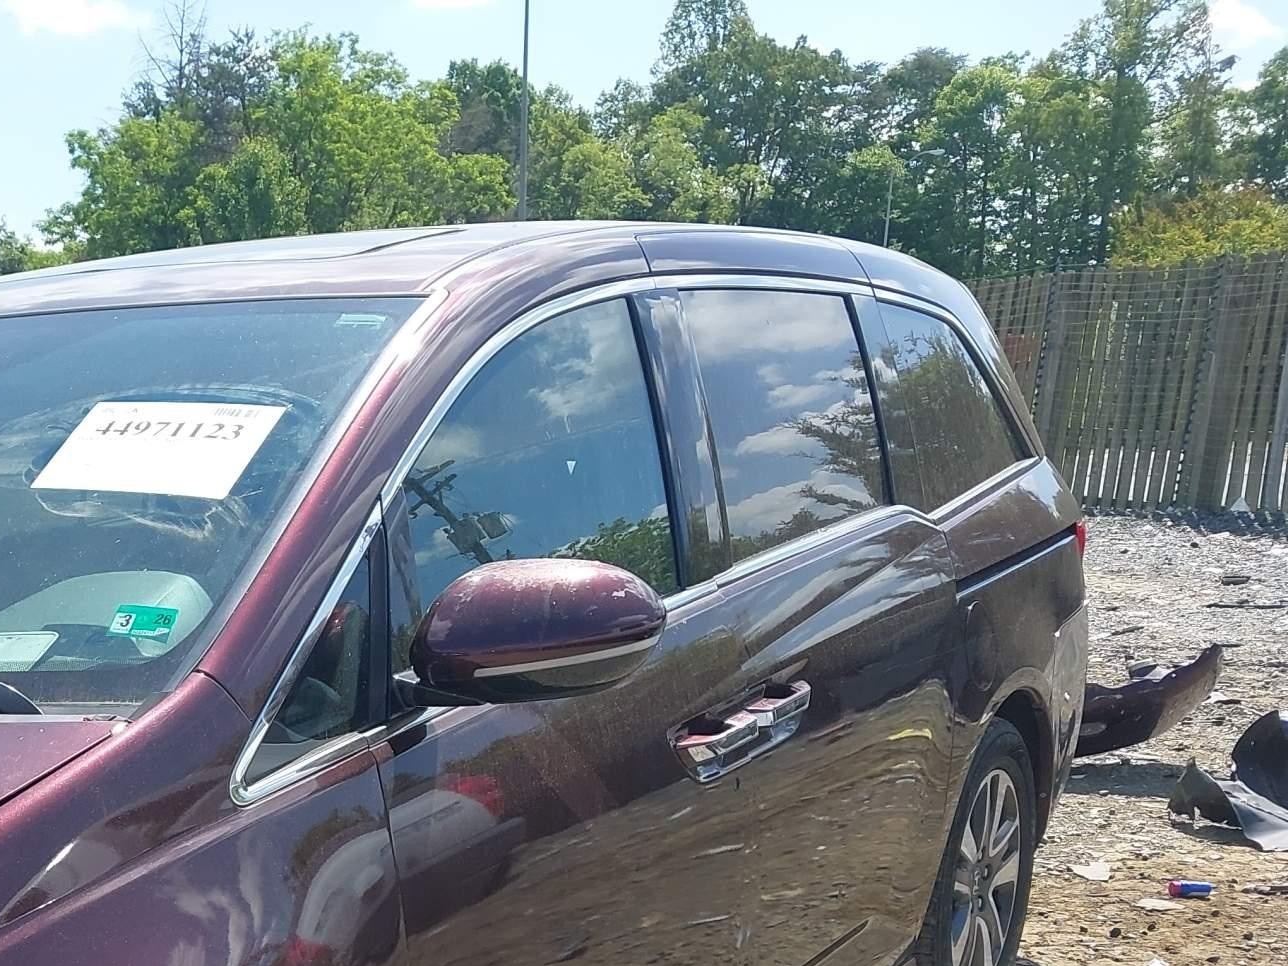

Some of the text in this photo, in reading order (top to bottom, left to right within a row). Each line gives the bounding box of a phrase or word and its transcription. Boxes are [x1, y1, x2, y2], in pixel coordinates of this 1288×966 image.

[95, 420, 245, 440] 44971123
[119, 613, 133, 627] 3
[153, 613, 173, 625] 26
